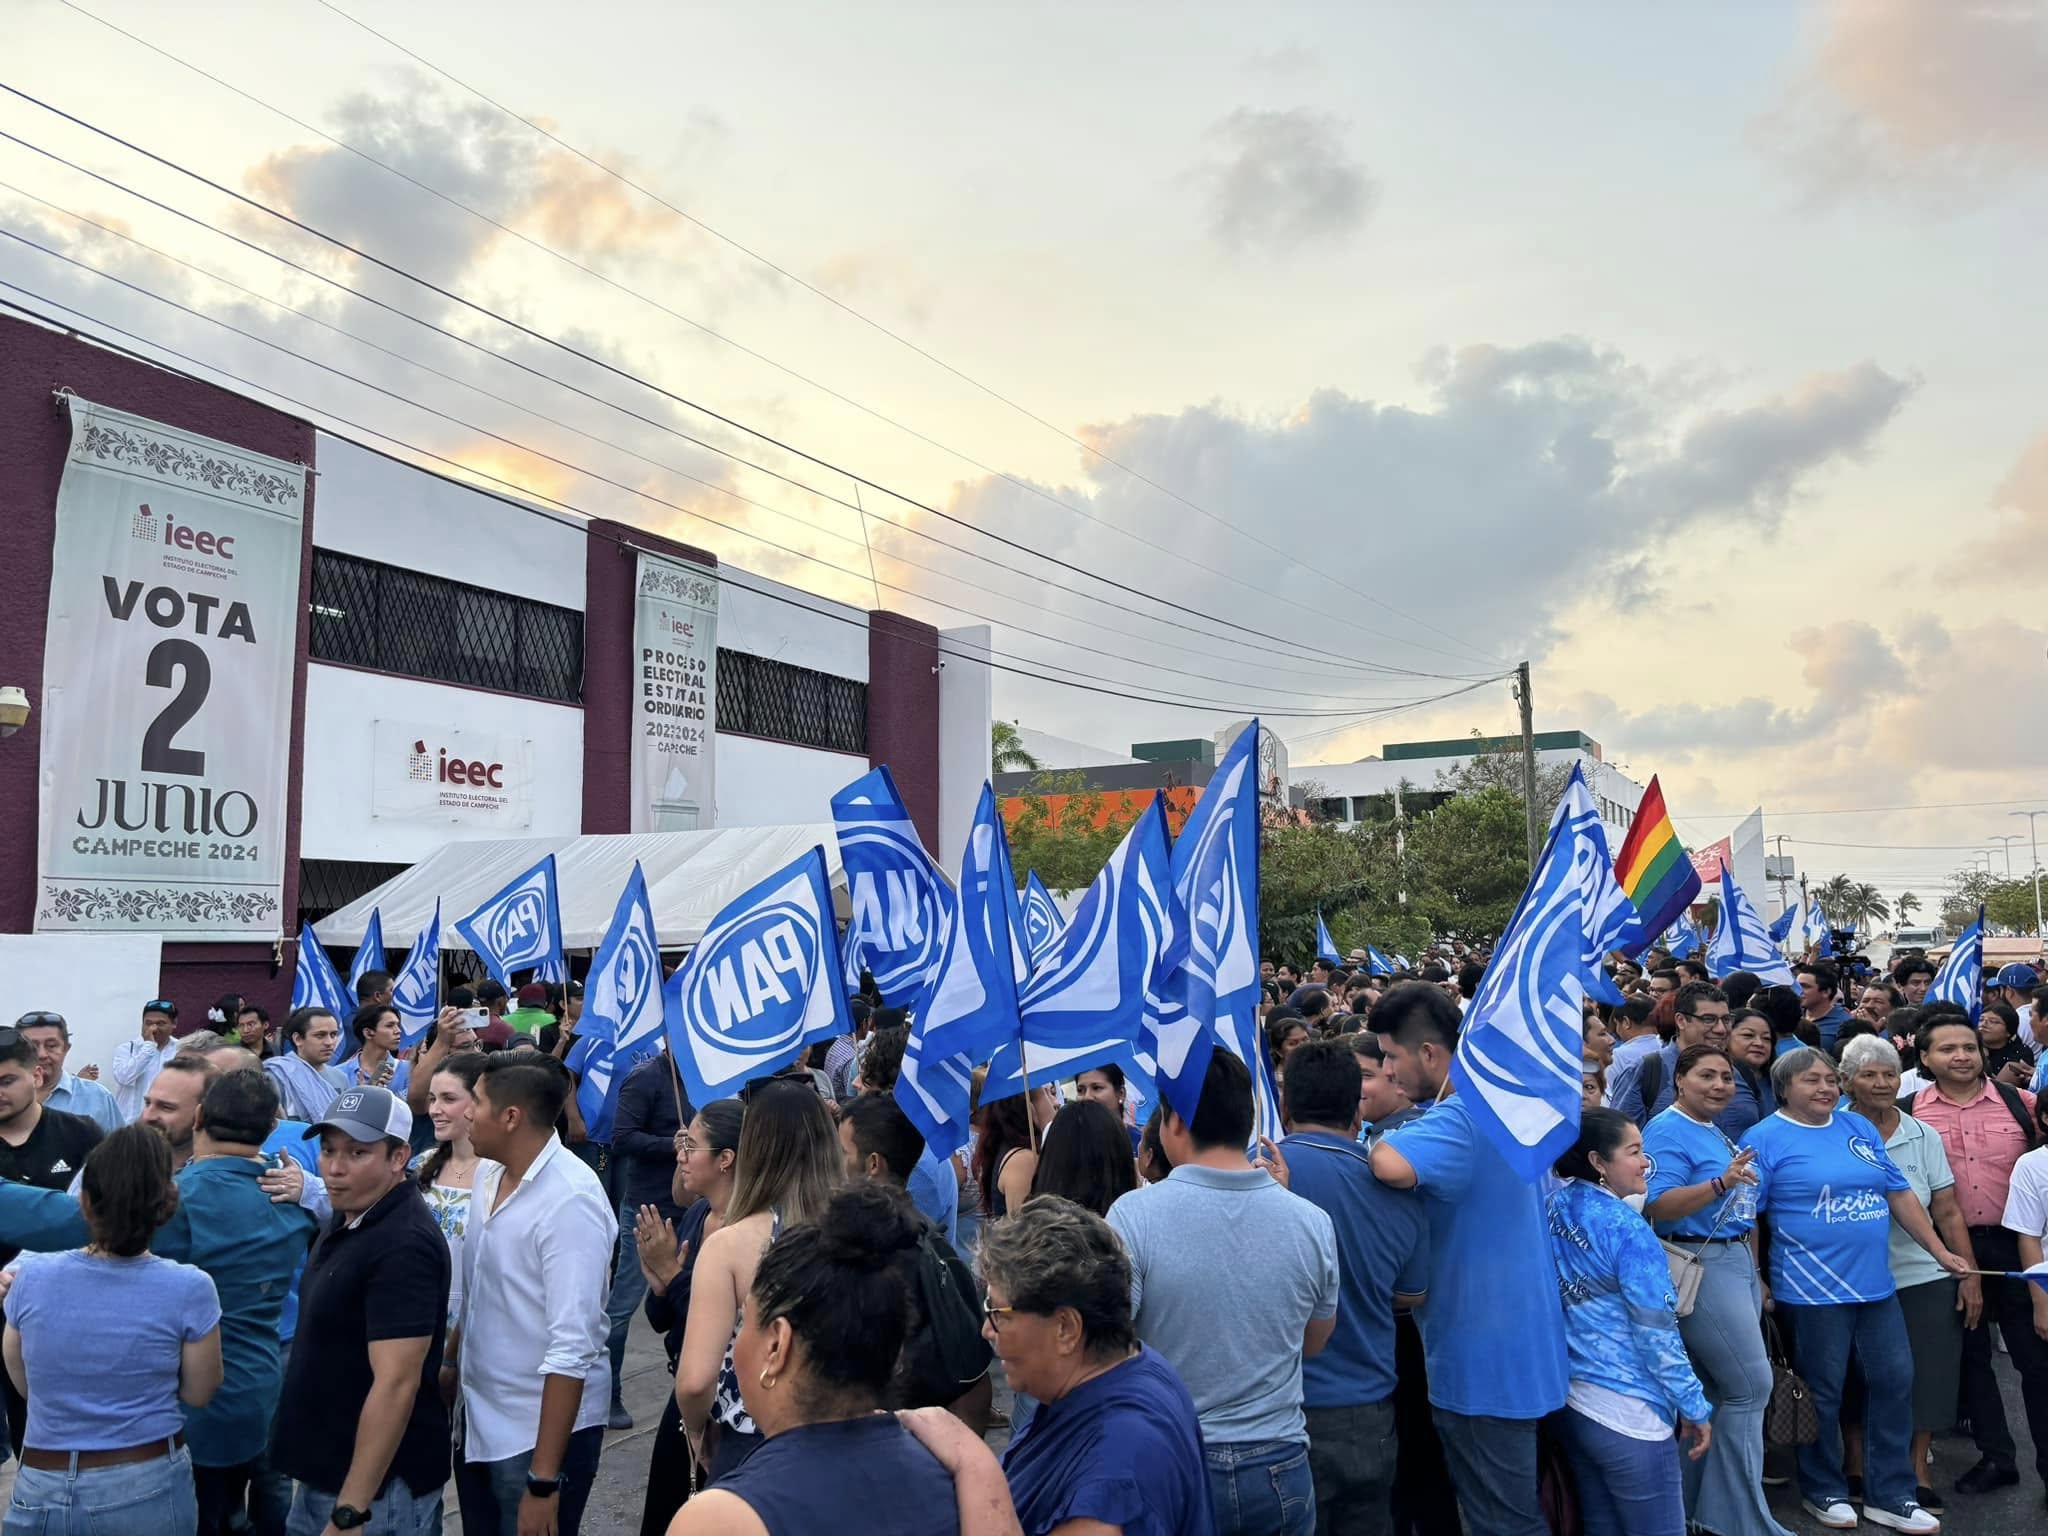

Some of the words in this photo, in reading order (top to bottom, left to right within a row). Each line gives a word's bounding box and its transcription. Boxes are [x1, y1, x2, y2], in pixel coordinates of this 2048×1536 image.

[165, 514, 235, 560] ieec
[163, 555, 194, 566] INSTITUTO
[195, 561, 227, 574] ELECTORAL
[163, 561, 187, 571] ESTADO
[196, 569, 228, 580] CAMPECHE
[103, 575, 257, 644] VOTA
[643, 666, 706, 689] ELECTRAL
[140, 638, 212, 777] 2
[439, 747, 504, 788] ieec
[77, 778, 258, 838] JUNIO
[439, 791, 468, 800] INSTITUTO
[468, 794, 498, 803] ELECTORAL
[439, 799, 461, 807] ESTADO
[470, 802, 500, 810] CAMPECHE
[73, 836, 201, 859] CAMPECHE
[208, 843, 258, 861] 2024
[1832, 1215, 1848, 1224] por
